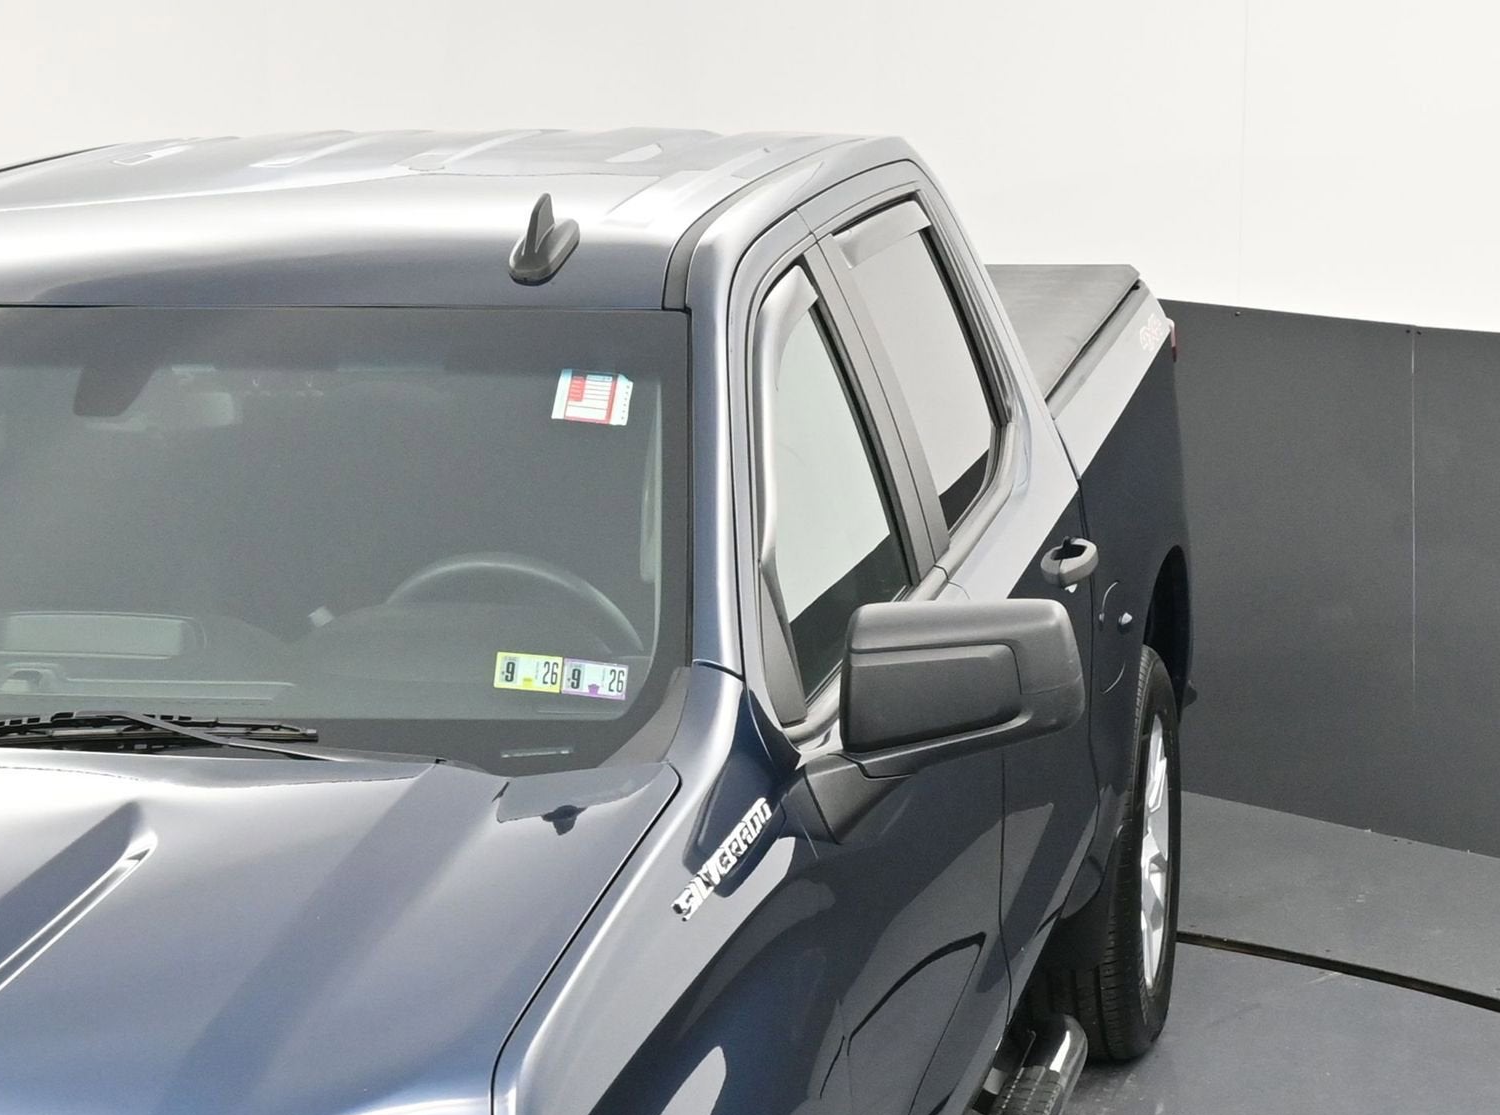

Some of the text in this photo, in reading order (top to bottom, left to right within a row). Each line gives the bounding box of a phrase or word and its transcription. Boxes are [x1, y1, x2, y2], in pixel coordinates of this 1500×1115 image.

[504, 661, 559, 685] 9 26
[570, 668, 625, 693] 9 26
